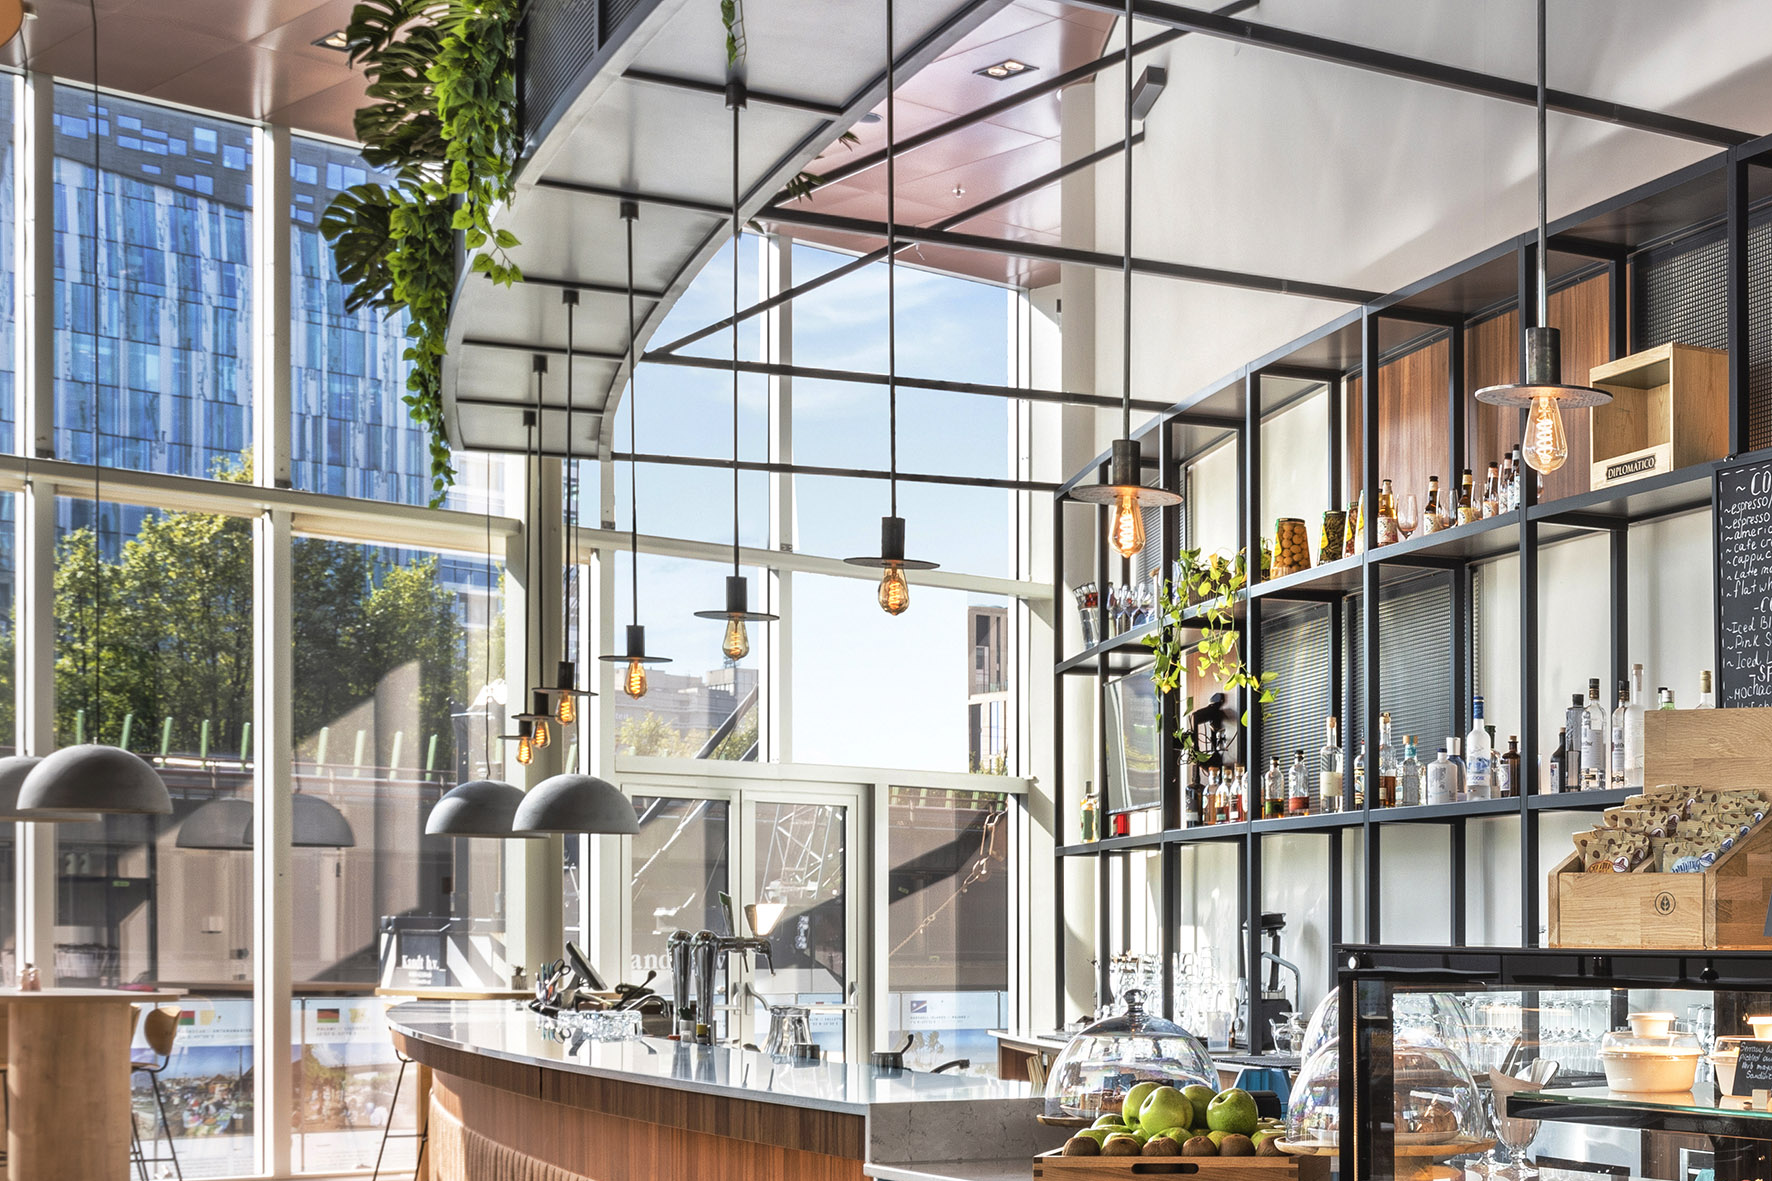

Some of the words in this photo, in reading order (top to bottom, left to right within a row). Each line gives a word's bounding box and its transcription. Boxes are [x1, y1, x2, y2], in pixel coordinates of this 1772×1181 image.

[1732, 511, 1771, 531] espresso
[1734, 539, 1757, 553] cafe
[1733, 578, 1756, 598] flat
[1731, 617, 1755, 634] Iced
[1735, 635, 1760, 649] Pink
[1735, 651, 1762, 670] Iced
